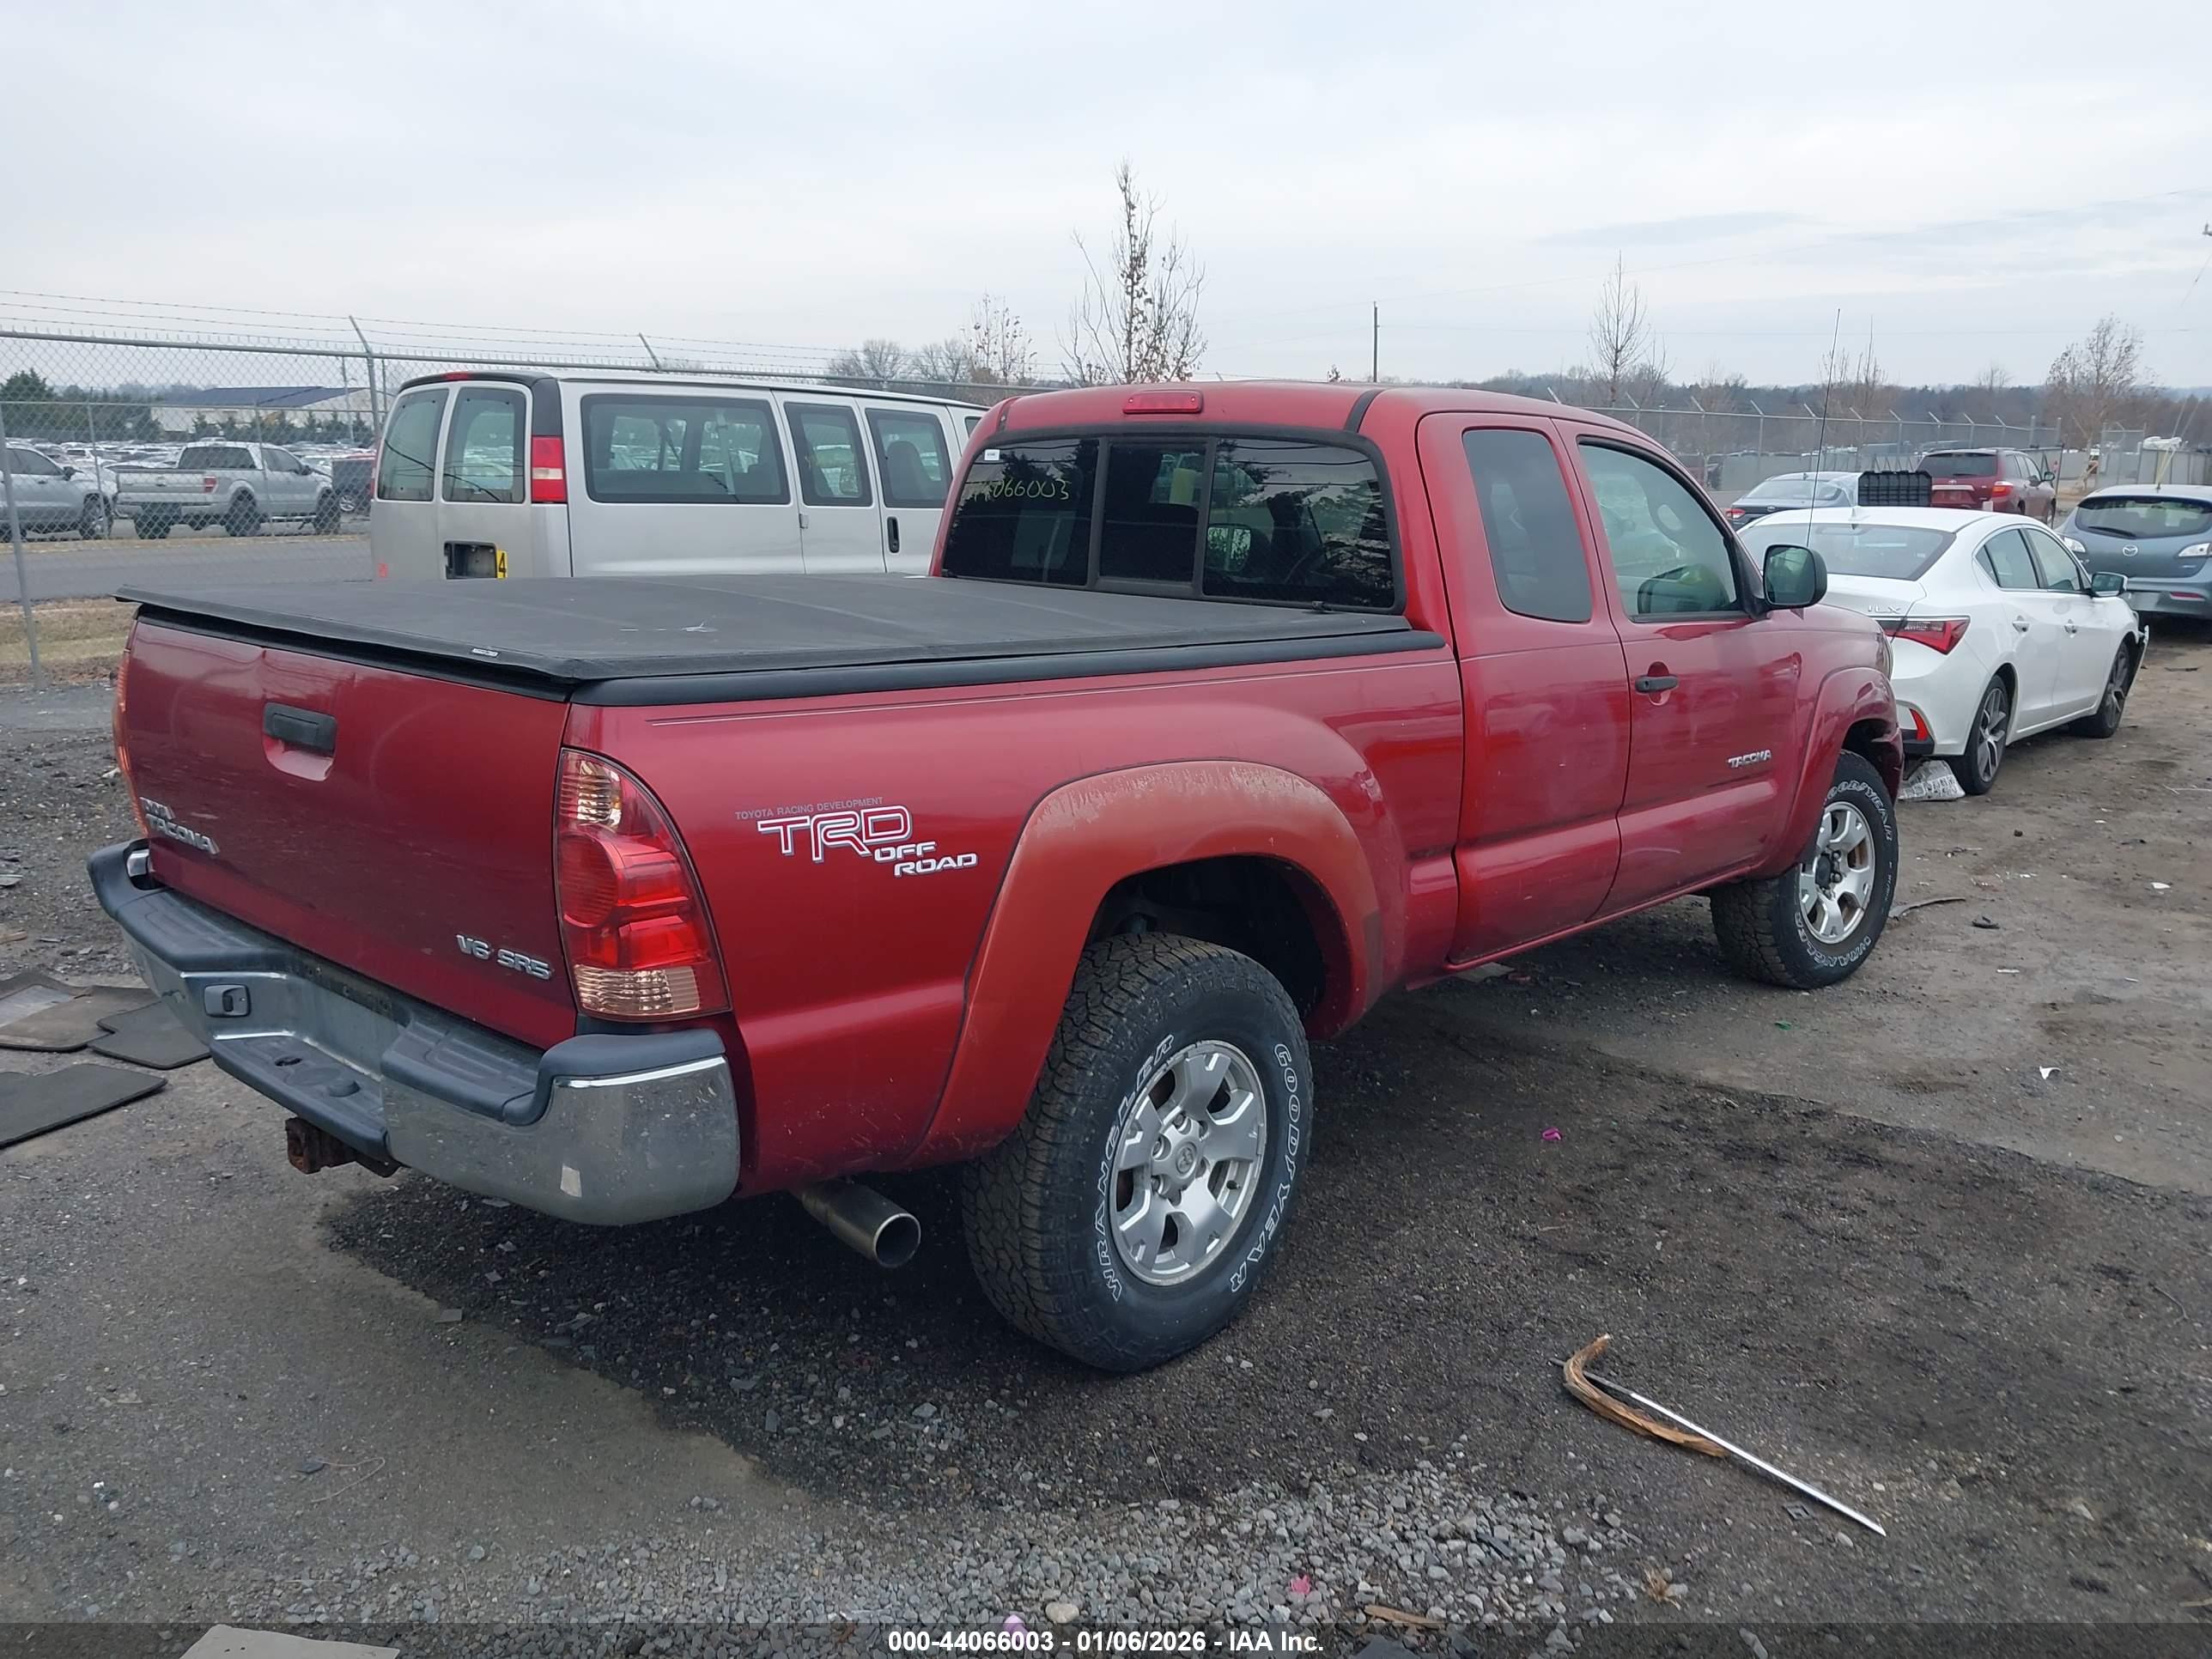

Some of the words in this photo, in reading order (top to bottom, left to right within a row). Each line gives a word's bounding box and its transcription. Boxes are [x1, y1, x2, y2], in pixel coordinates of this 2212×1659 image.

[1868, 604, 1901, 615] ILX
[1728, 749, 1771, 769] TACOMA
[735, 808, 775, 820] TOYOTA
[776, 804, 814, 816] RACING
[817, 796, 884, 811] DEVELOPMENT
[1824, 780, 1893, 842] OODYEAR
[145, 813, 220, 854] TACOMA
[757, 805, 912, 862] TRD
[873, 841, 937, 863] OFF
[893, 853, 978, 877] ROAD
[456, 933, 490, 960] V6
[497, 948, 551, 980] SR5
[1094, 1034, 1175, 1301] WRANGLER
[1231, 1043, 1301, 1292] GOODYEAR
